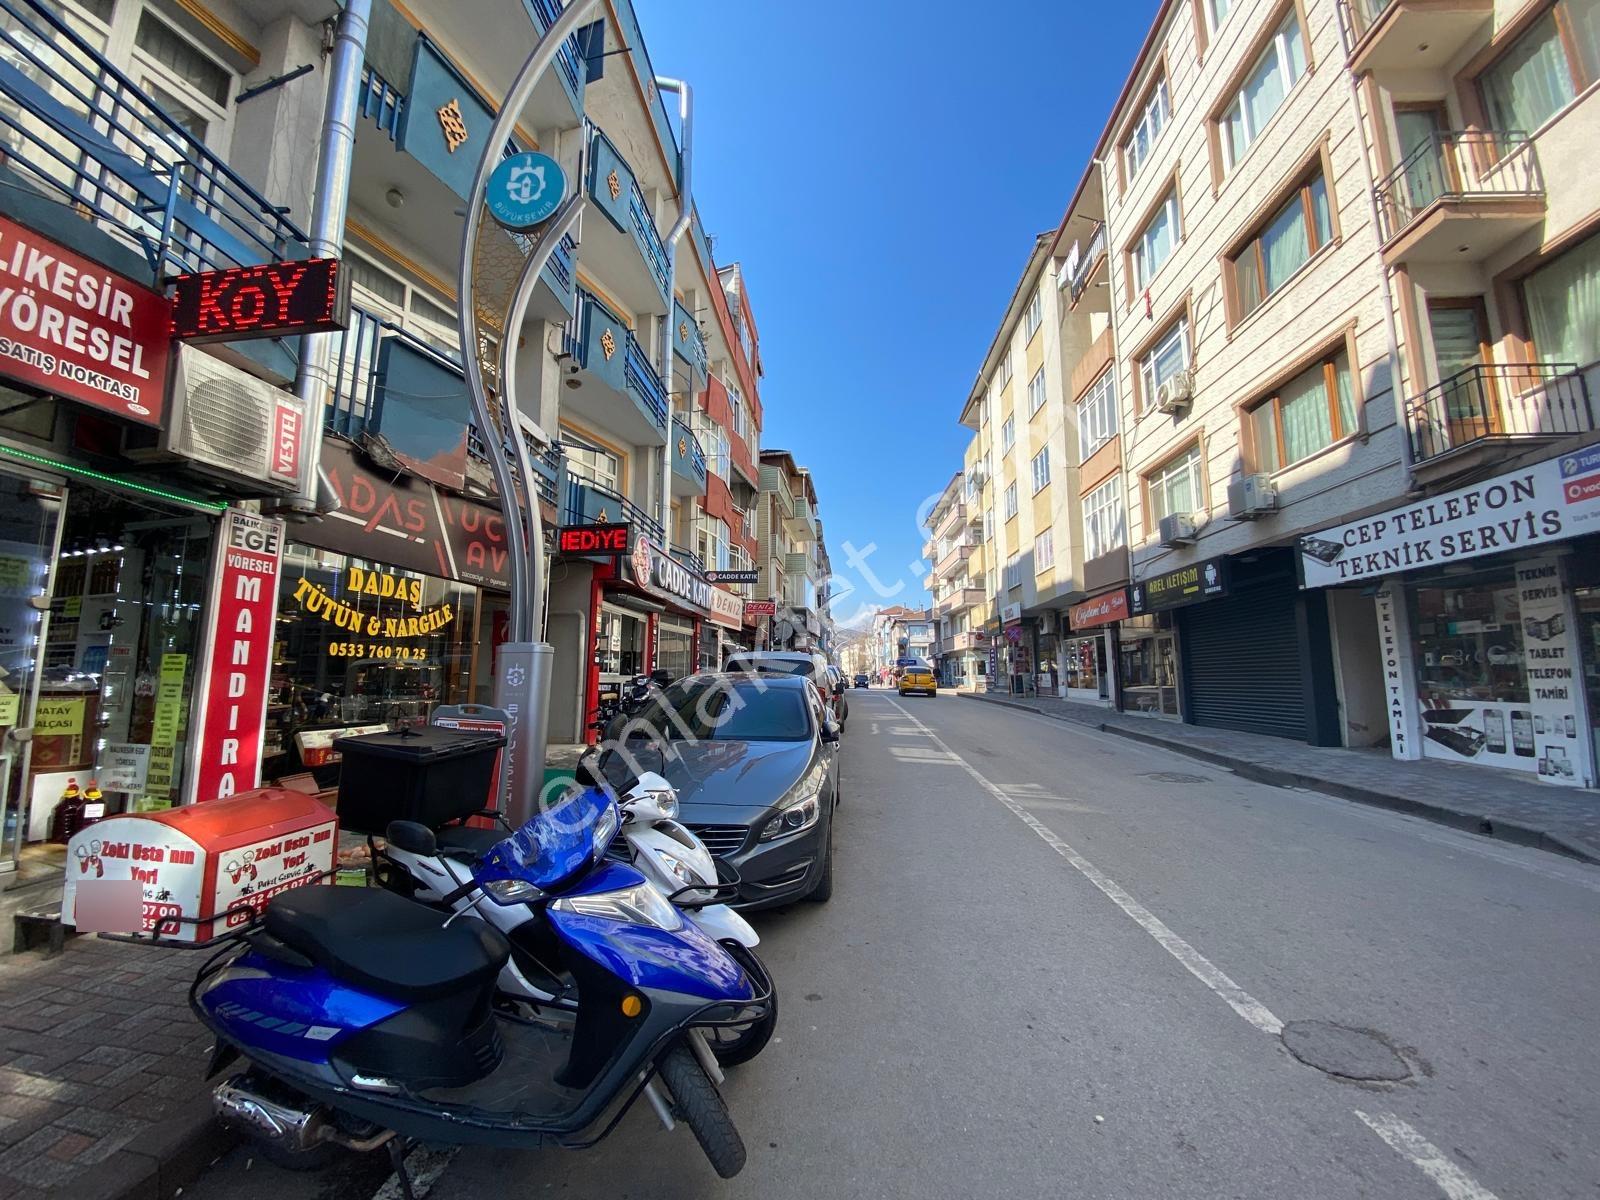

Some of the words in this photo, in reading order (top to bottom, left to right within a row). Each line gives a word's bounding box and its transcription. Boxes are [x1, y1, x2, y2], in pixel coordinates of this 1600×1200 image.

[198, 268, 307, 328] KÖY
[59, 360, 139, 403] NOKTASI
[278, 411, 297, 472] VESTEL
[1343, 520, 1387, 548] CEP
[1391, 475, 1536, 536] TELEFON
[230, 526, 278, 555] EGE
[1336, 541, 1434, 578] TEKNİK
[1440, 509, 1563, 557] SERVİS
[228, 552, 275, 575] YÖRESEL
[1518, 564, 1557, 580] TEKNİK
[348, 567, 422, 609] DADAŞ
[658, 556, 691, 600] CADDE
[718, 573, 739, 581] CADDE
[740, 573, 758, 581] KATIK
[1149, 580, 1166, 593] AREL
[1522, 584, 1558, 601] SERVİS
[293, 577, 365, 633] TÜTÜN
[366, 616, 381, 636] &
[385, 604, 454, 638] NARGİLE
[329, 642, 364, 657] 0533
[369, 645, 392, 659] 760
[395, 647, 409, 659] 70
[412, 648, 426, 660] 25
[1380, 602, 1398, 679] TELEFON
[1529, 647, 1565, 659] TABLET
[1528, 668, 1572, 679] TELEFON
[217, 574, 262, 800] MANDIRA
[1535, 685, 1568, 700] TAMİRİ
[36, 707, 72, 715] HATAY
[35, 720, 73, 729] ALÇASI
